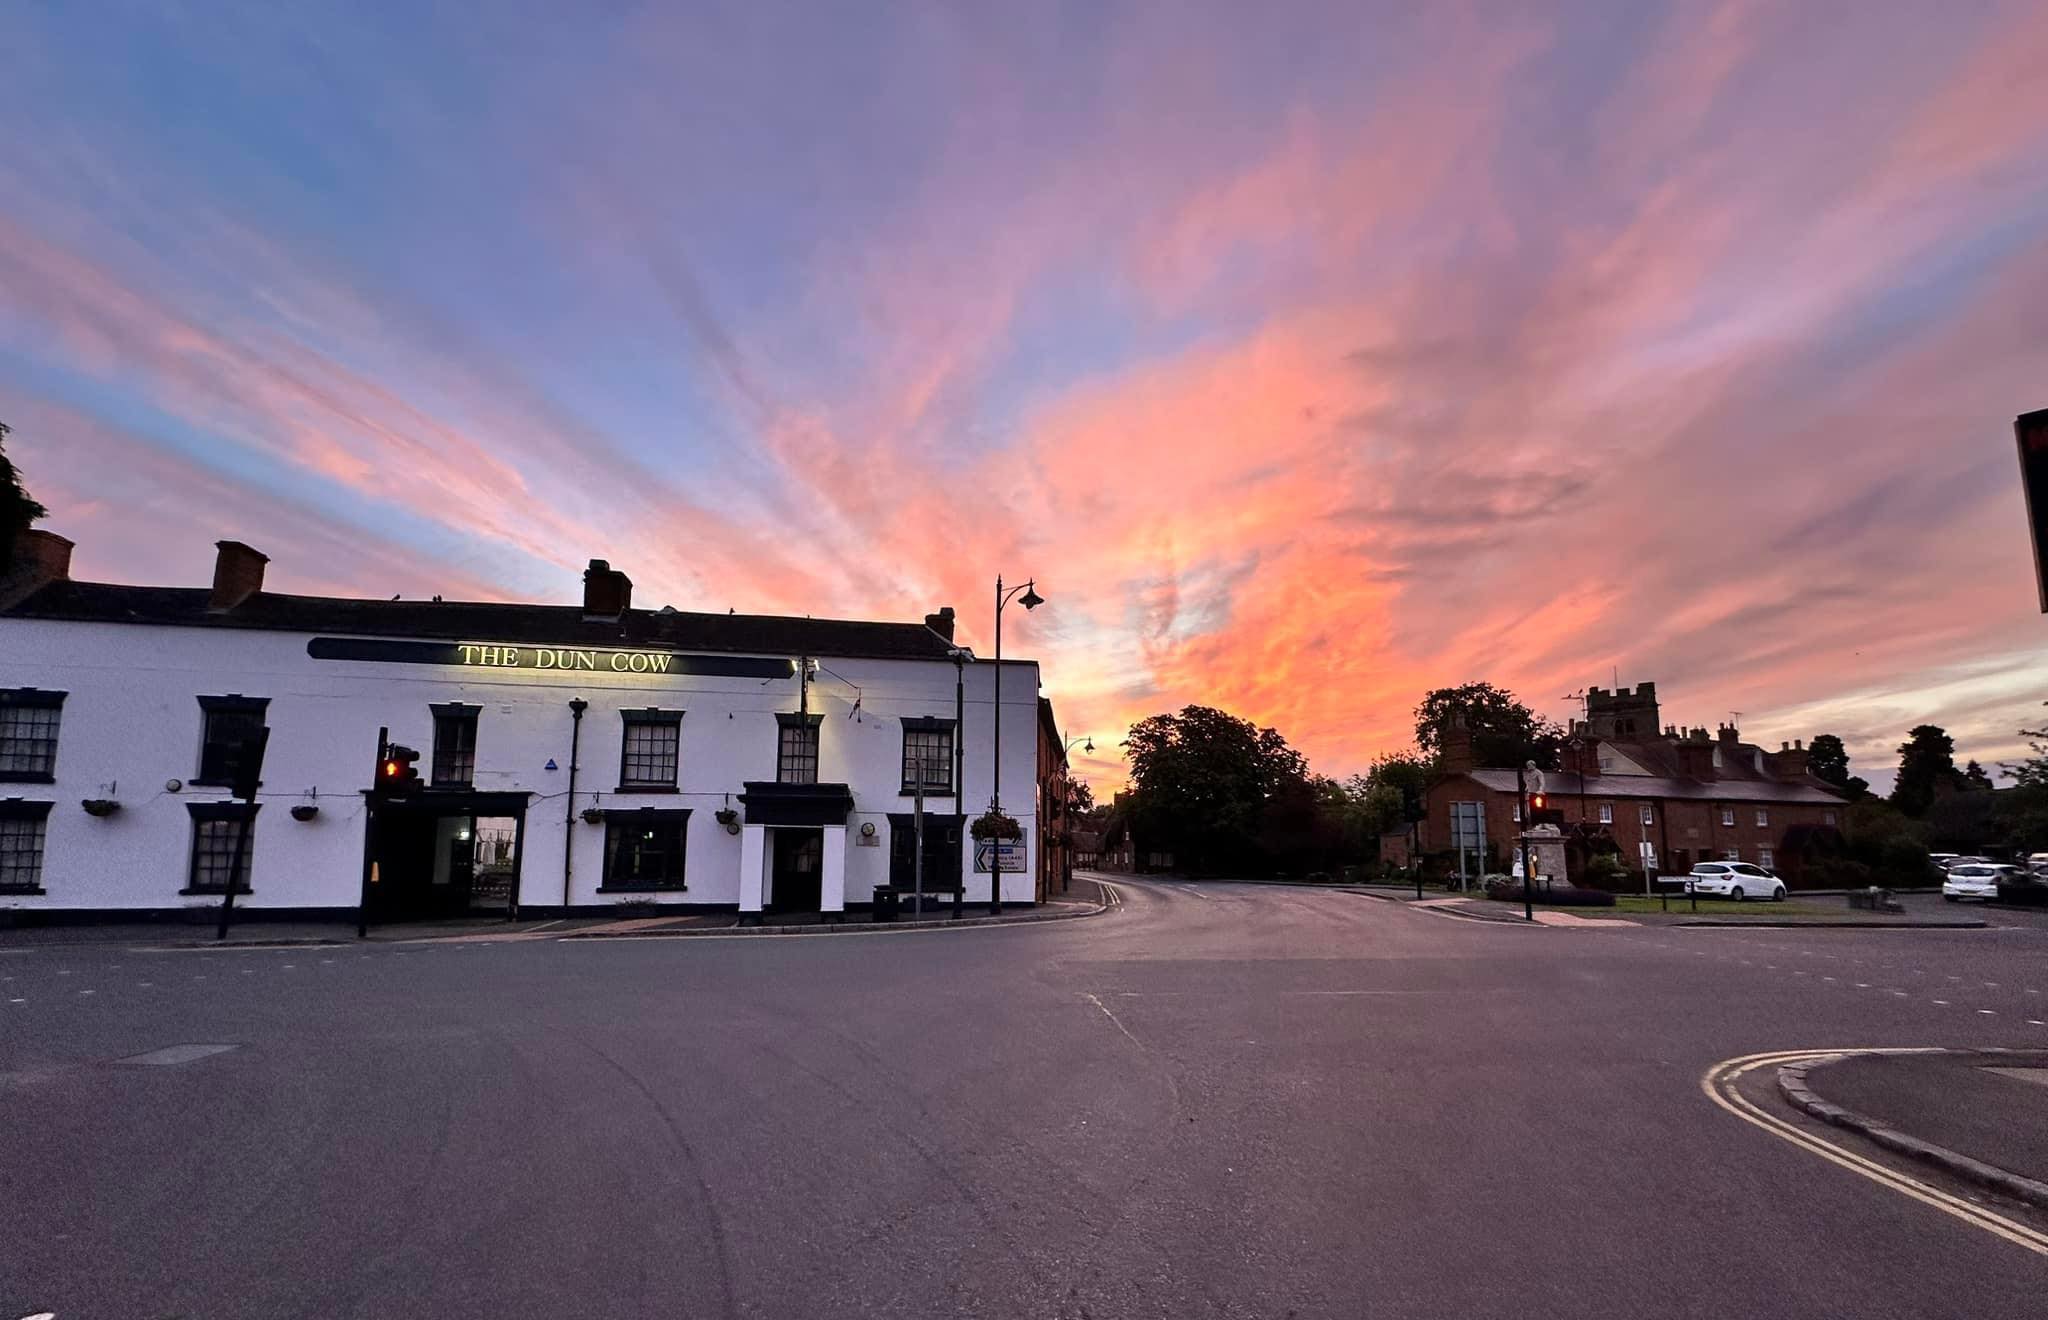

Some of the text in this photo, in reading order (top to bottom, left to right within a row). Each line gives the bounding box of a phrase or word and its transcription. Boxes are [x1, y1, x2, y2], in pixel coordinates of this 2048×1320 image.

[457, 645, 672, 672] THE DUN COW
